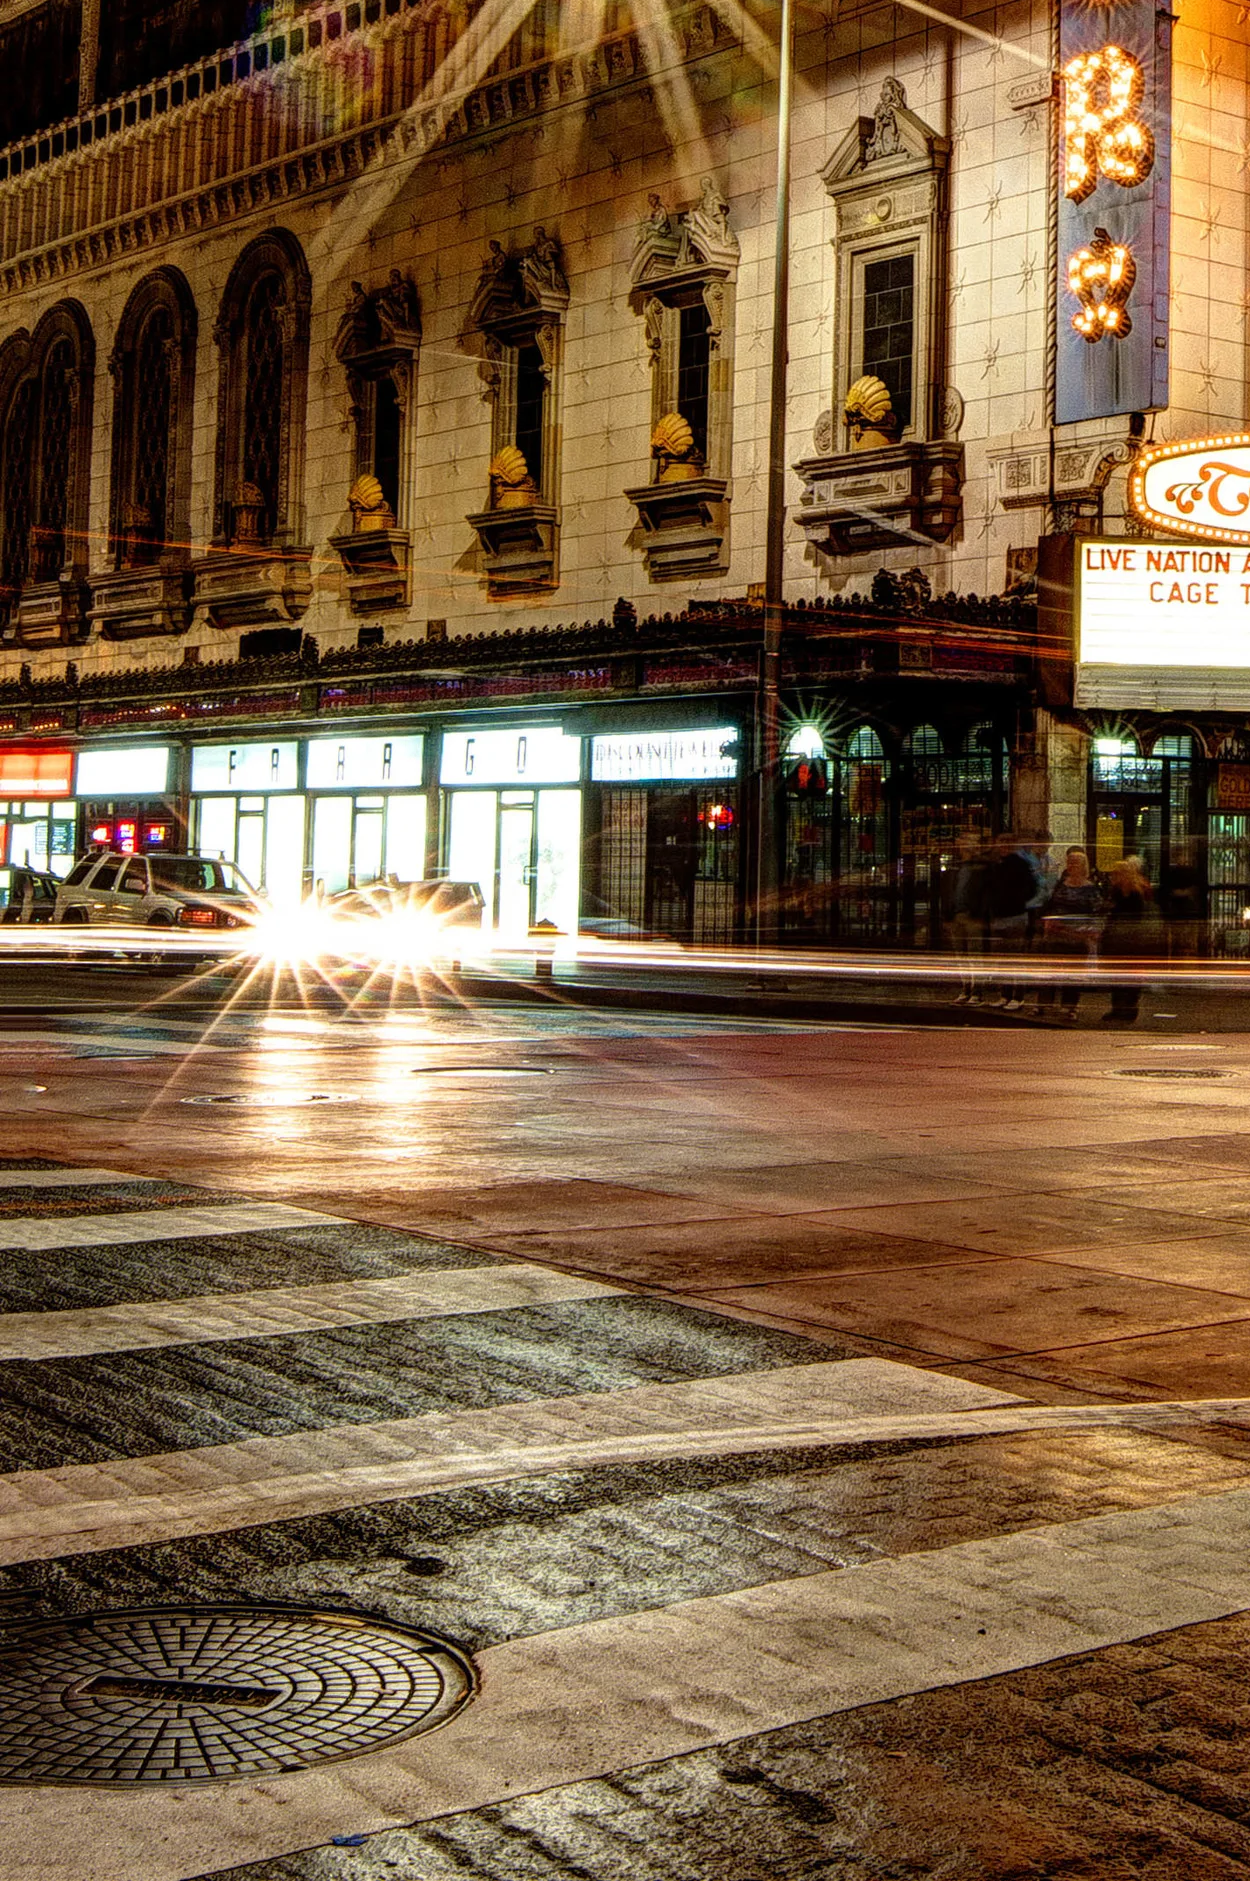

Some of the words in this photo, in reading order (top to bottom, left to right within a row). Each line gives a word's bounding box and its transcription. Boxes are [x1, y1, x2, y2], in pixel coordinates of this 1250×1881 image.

[1086, 548, 1135, 571] LIVE
[1146, 551, 1230, 573] NATION
[1150, 581, 1218, 604] CAGE
